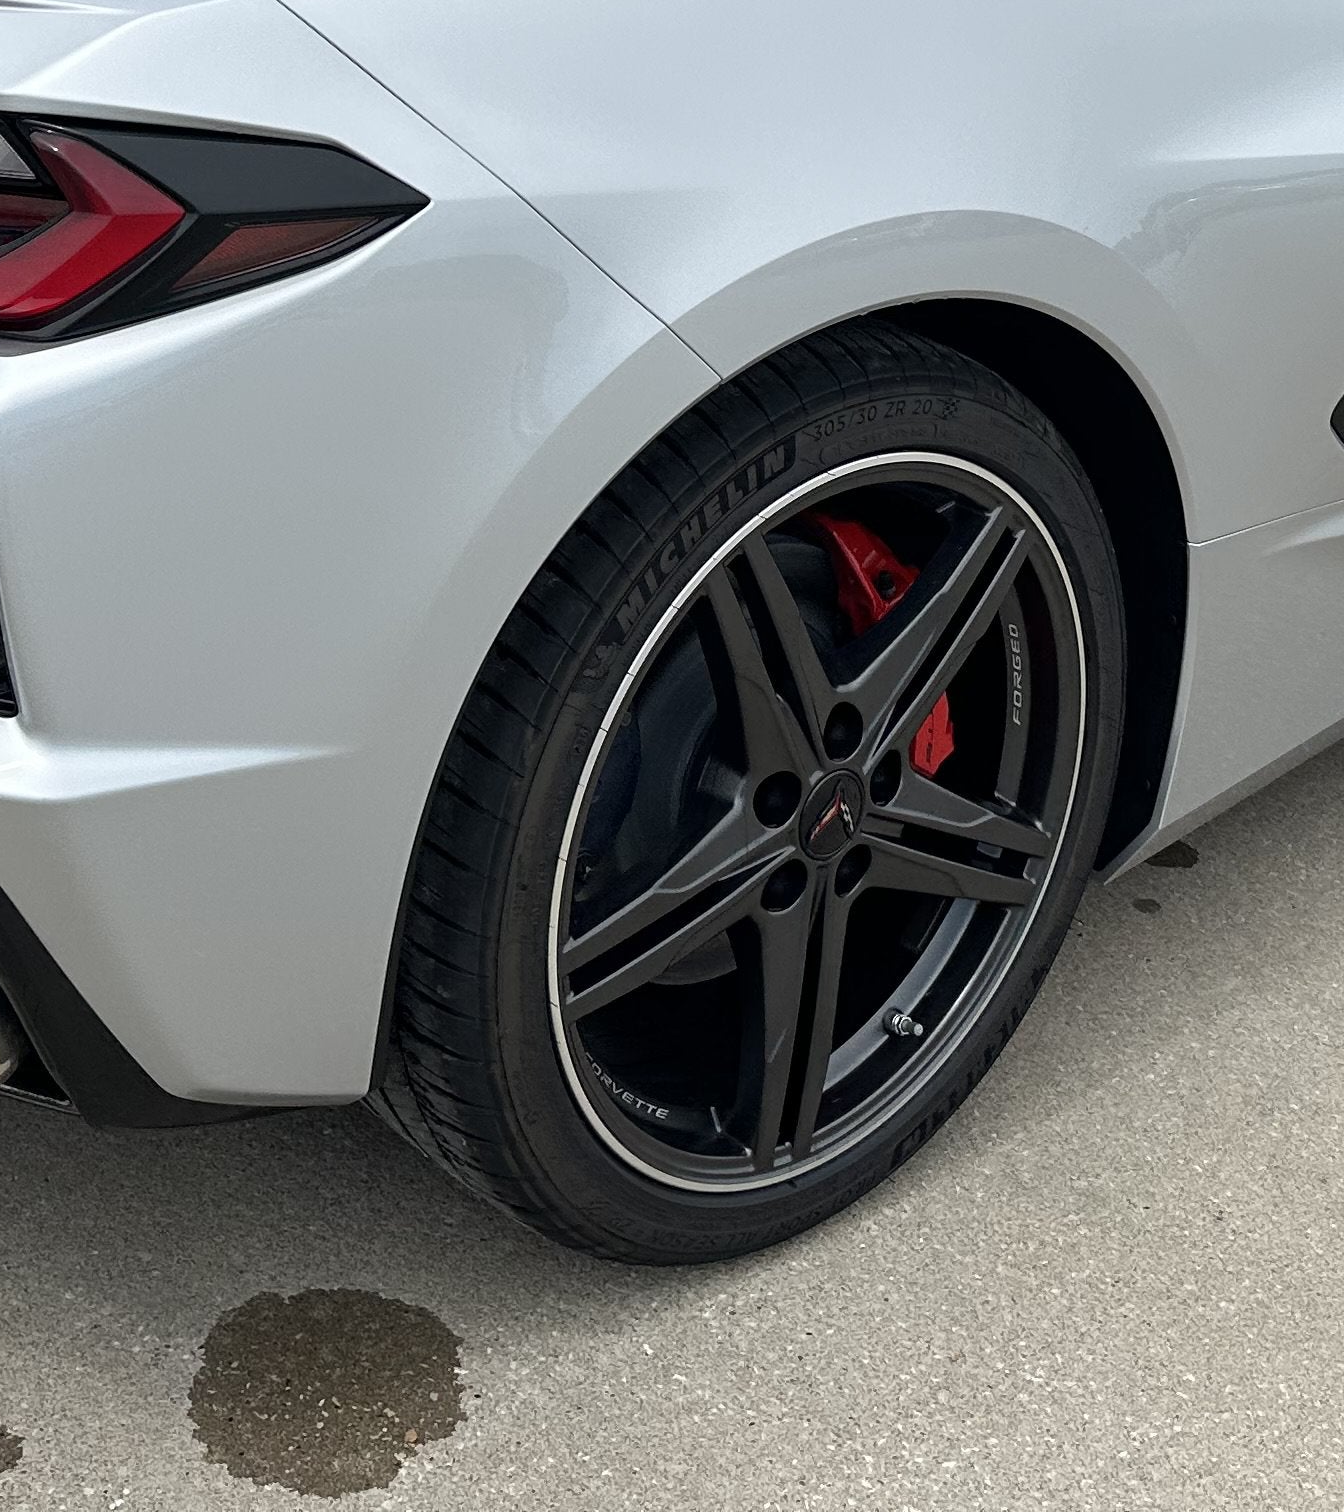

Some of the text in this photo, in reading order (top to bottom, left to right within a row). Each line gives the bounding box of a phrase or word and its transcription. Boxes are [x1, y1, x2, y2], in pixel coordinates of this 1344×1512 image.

[813, 398, 933, 441] 305/30 ZR 20
[615, 443, 787, 636] MICHELIN
[1008, 623, 1023, 726] FORGED
